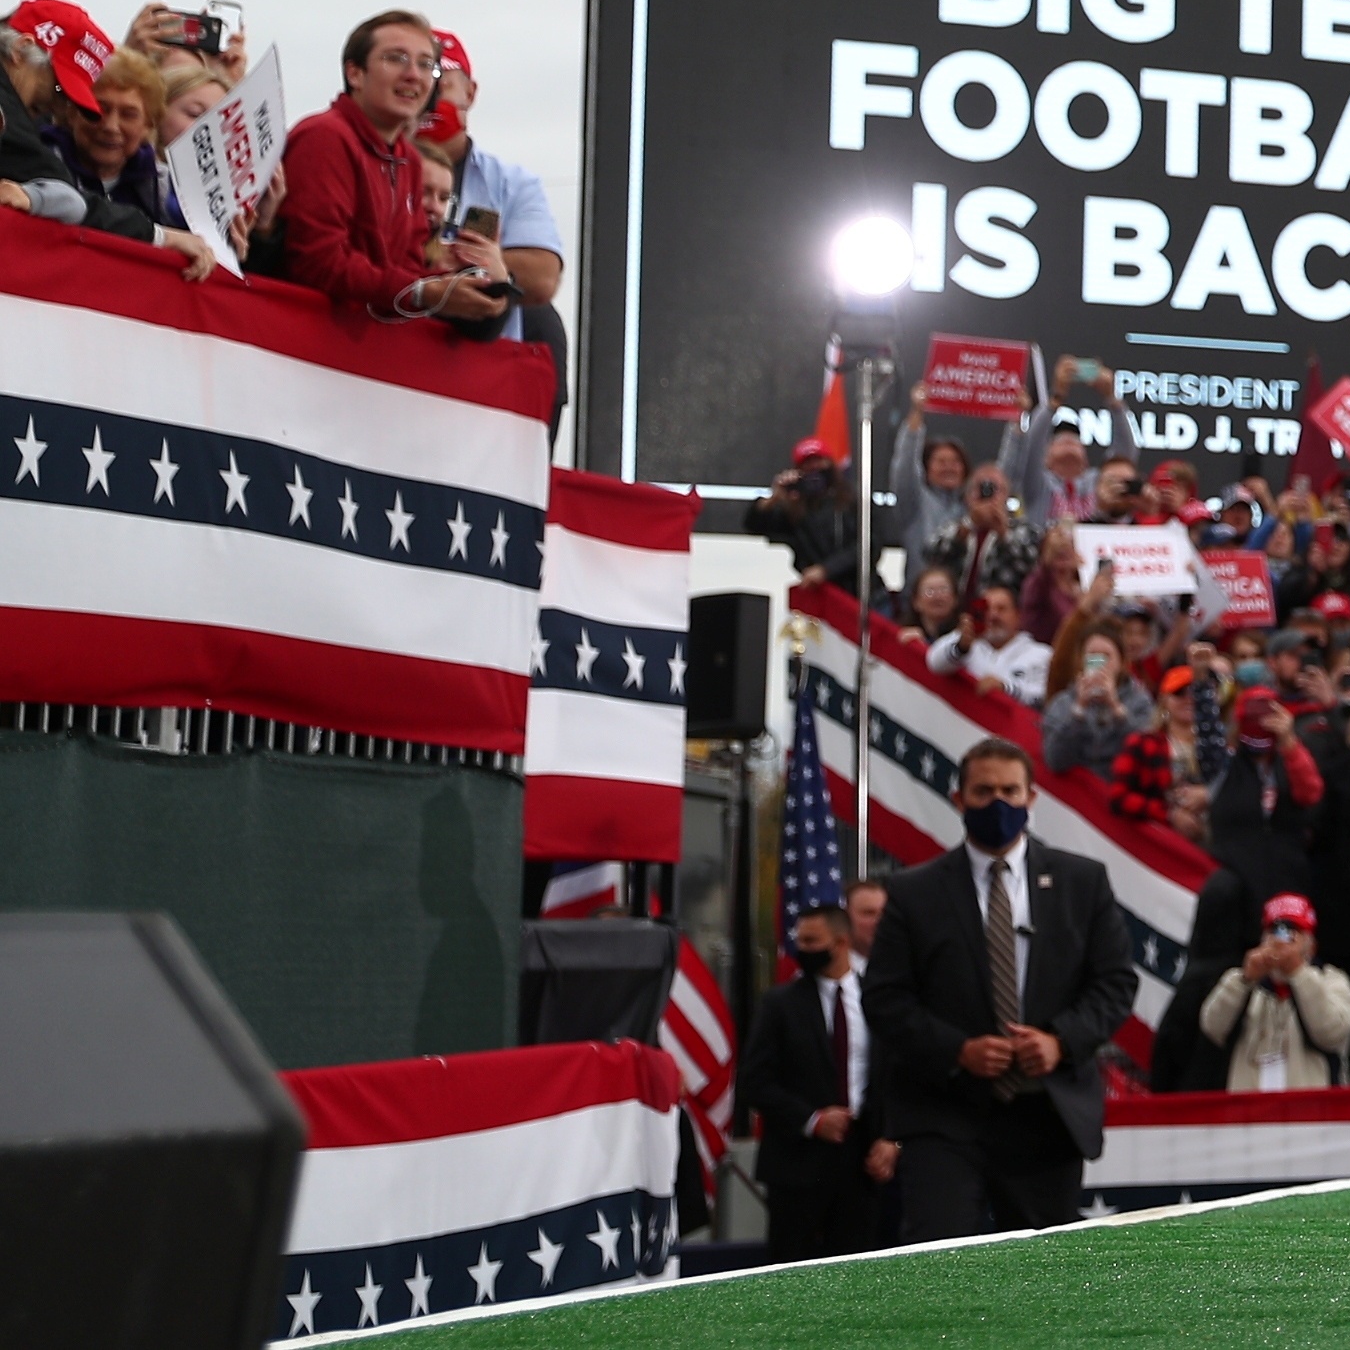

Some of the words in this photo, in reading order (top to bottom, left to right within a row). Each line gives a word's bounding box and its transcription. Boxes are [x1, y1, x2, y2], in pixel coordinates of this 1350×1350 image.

[34, 20, 65, 47] 45
[192, 123, 219, 186] GREAT
[254, 100, 274, 160] MAKE
[217, 98, 260, 216] AMERICA
[910, 181, 1041, 299] IS
[931, 365, 1021, 391] AMERICA
[1113, 369, 1299, 411] PRESIDENT
[1204, 415, 1242, 454] J.
